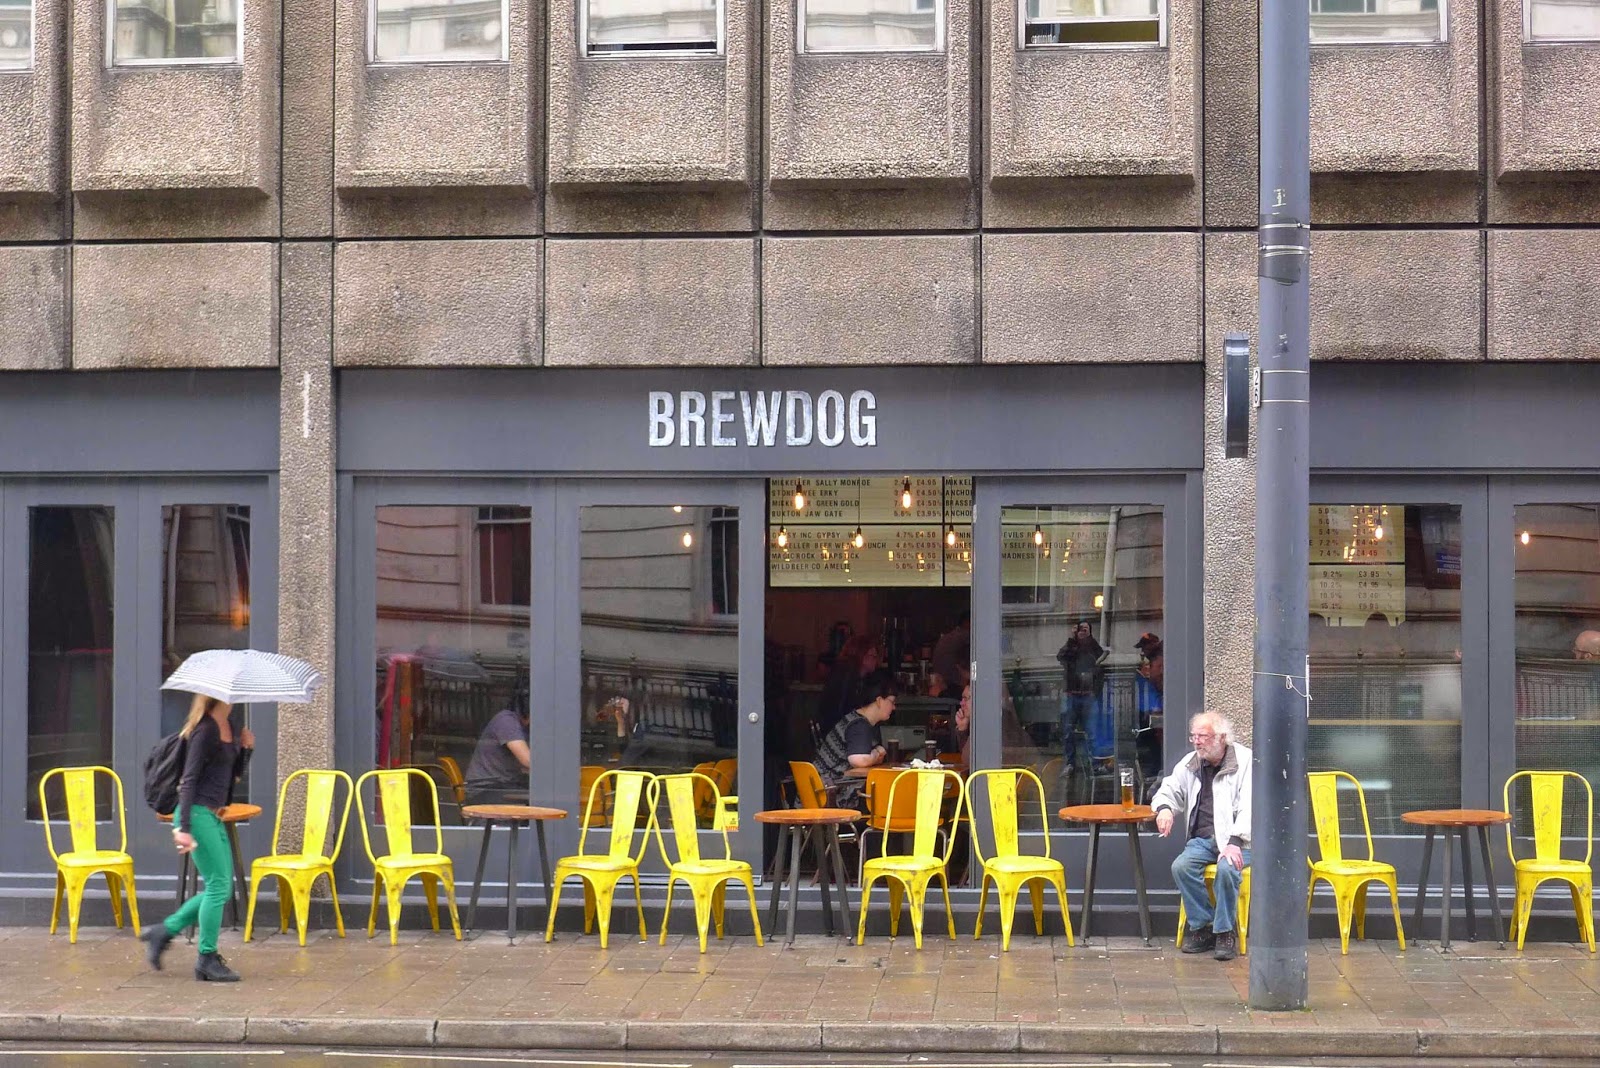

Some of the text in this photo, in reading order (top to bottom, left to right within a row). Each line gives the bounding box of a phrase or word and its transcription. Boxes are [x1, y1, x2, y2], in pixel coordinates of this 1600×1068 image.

[649, 390, 877, 447] BREWDOG
[815, 479, 838, 487] SALLY
[840, 479, 871, 487] MONROE
[771, 510, 801, 518] BUXTON
[804, 510, 820, 518] JAW
